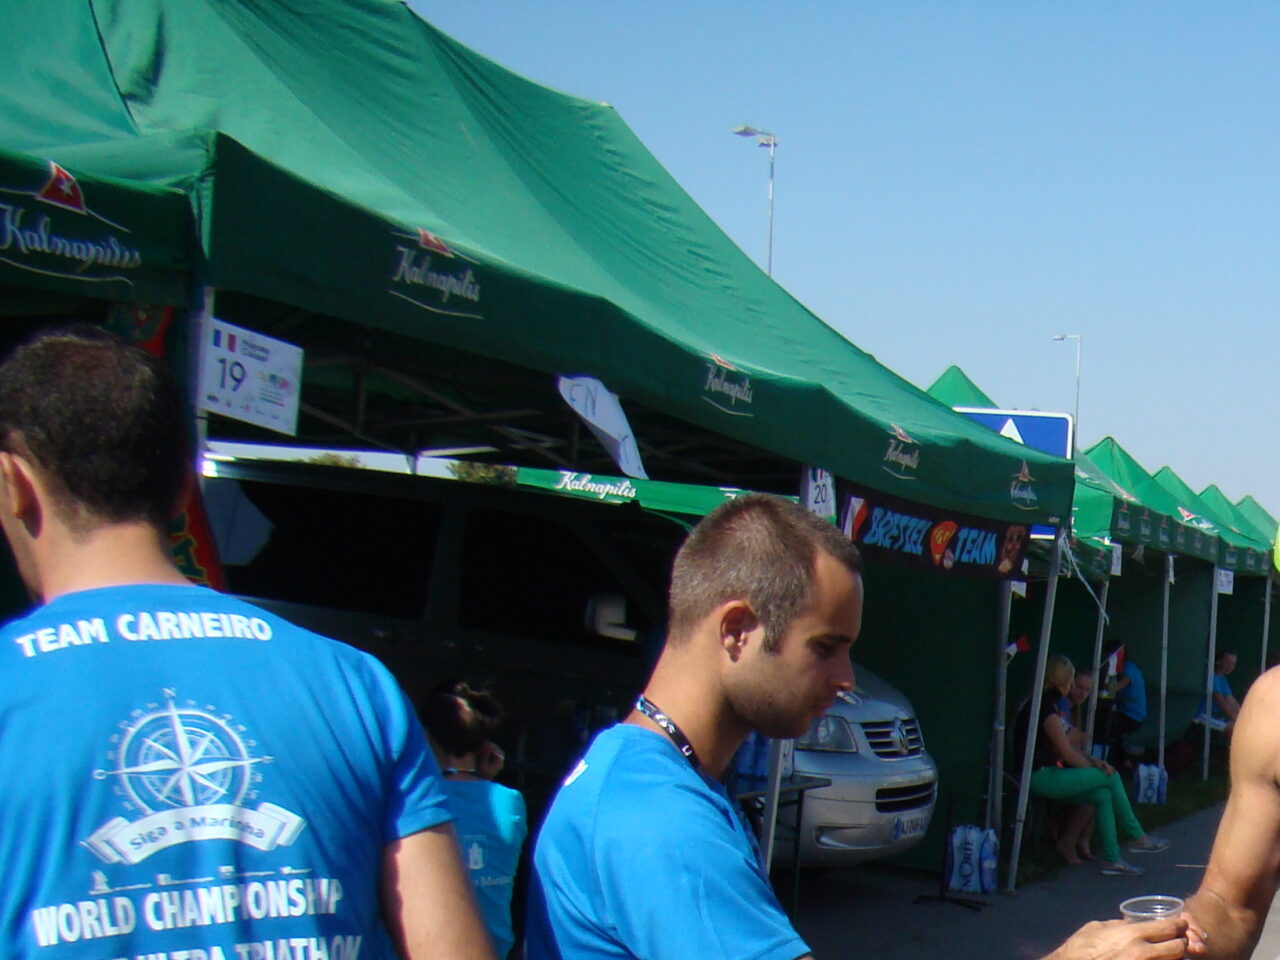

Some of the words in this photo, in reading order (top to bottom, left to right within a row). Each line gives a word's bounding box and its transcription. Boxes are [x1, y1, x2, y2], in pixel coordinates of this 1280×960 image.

[0, 202, 142, 272] Kalnapilis
[390, 245, 481, 303] Kalnapilis
[217, 357, 247, 392] 19
[554, 470, 637, 498] Kalnapilis
[814, 484, 827, 504] 20
[955, 527, 997, 565] TEAM
[16, 618, 108, 658] TEAM
[117, 612, 272, 642] CARNEIRO
[33, 897, 136, 947] WORLD
[144, 878, 343, 931] CHAMPIONSHIP
